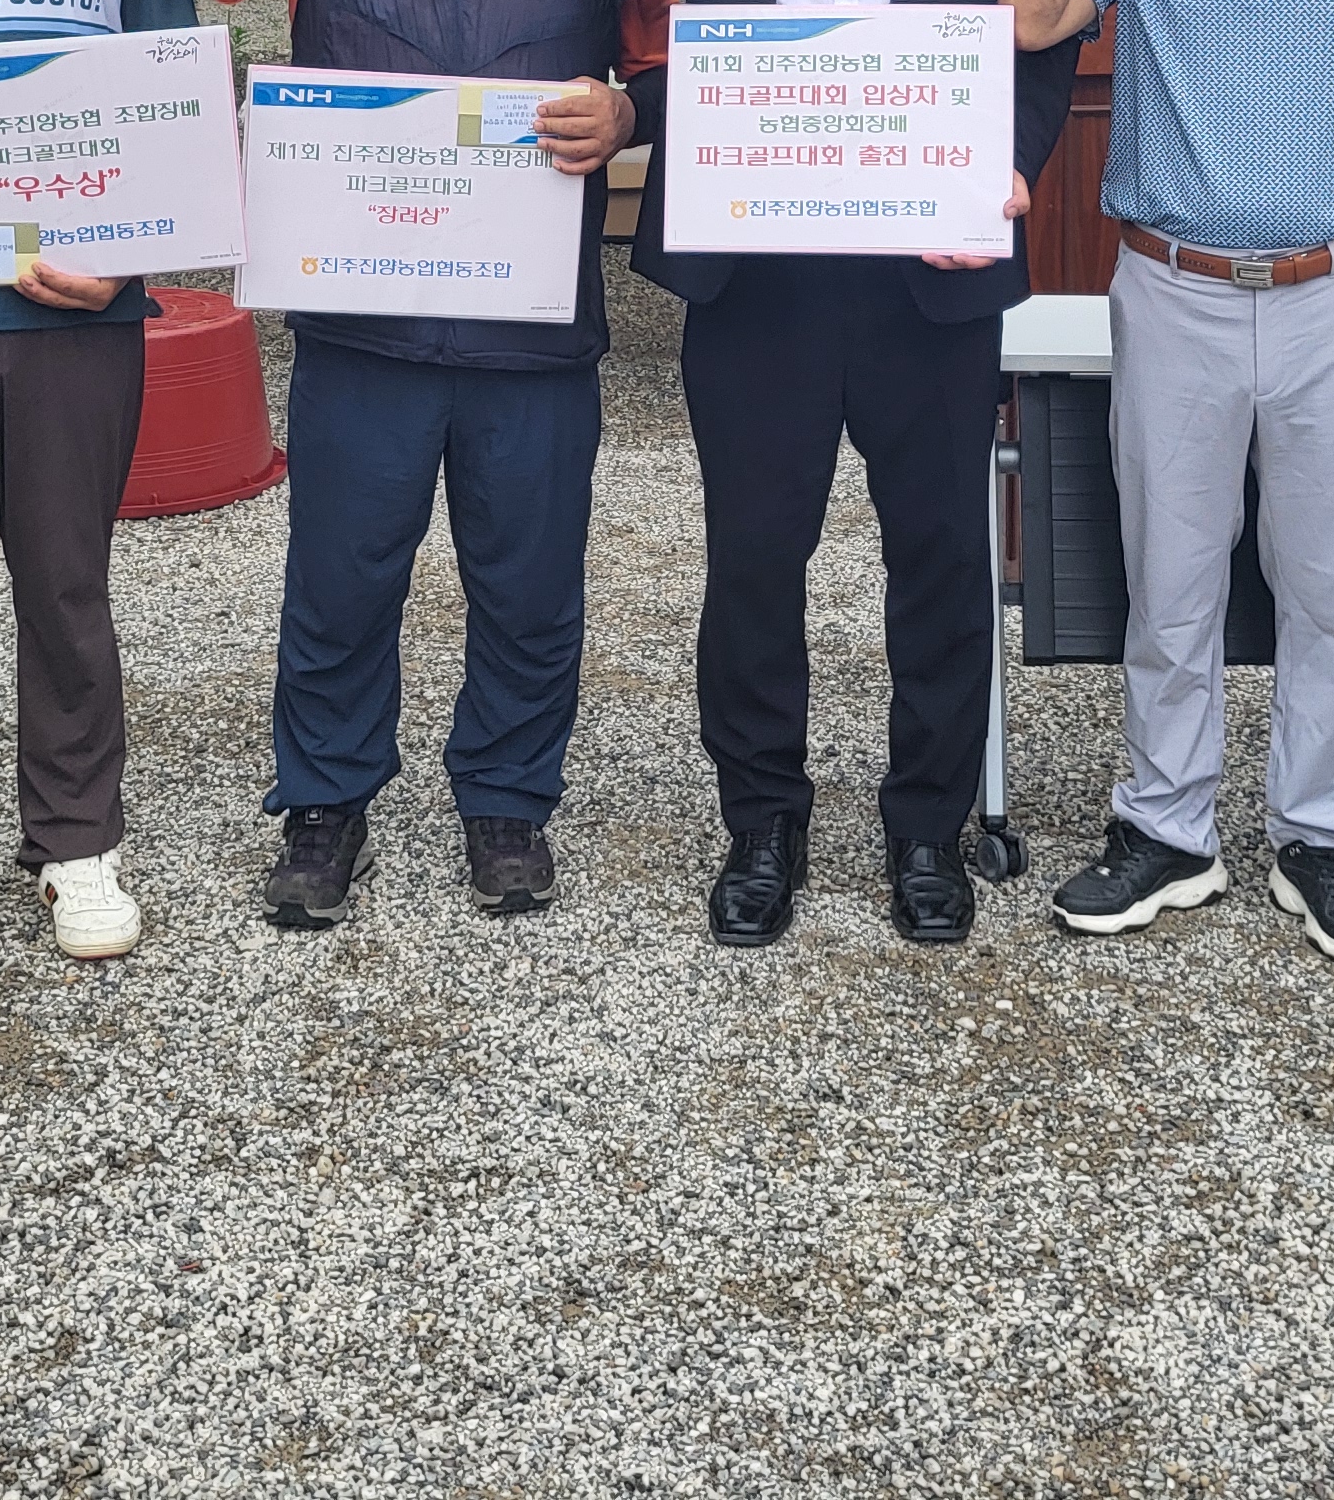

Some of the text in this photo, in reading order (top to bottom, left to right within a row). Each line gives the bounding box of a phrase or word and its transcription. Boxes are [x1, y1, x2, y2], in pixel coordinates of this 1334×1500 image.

[699, 23, 753, 38] NH
[689, 52, 981, 74] 제1회 진주진양농협 조합장배
[277, 87, 333, 105] NH
[697, 83, 971, 107] 파크골프대회 입상자 및
[114, 98, 202, 127] 조합장배
[758, 113, 908, 134] 농협중앙회장배
[265, 142, 554, 170] 제1회 진주진양농협 조합장배
[695, 144, 973, 168] 파크골프대회 출전 대상
[345, 174, 473, 197] 파크골프대회
[749, 199, 938, 218] 진주진양농업협동조합
[319, 256, 513, 280] 진주진양농업협동조합
